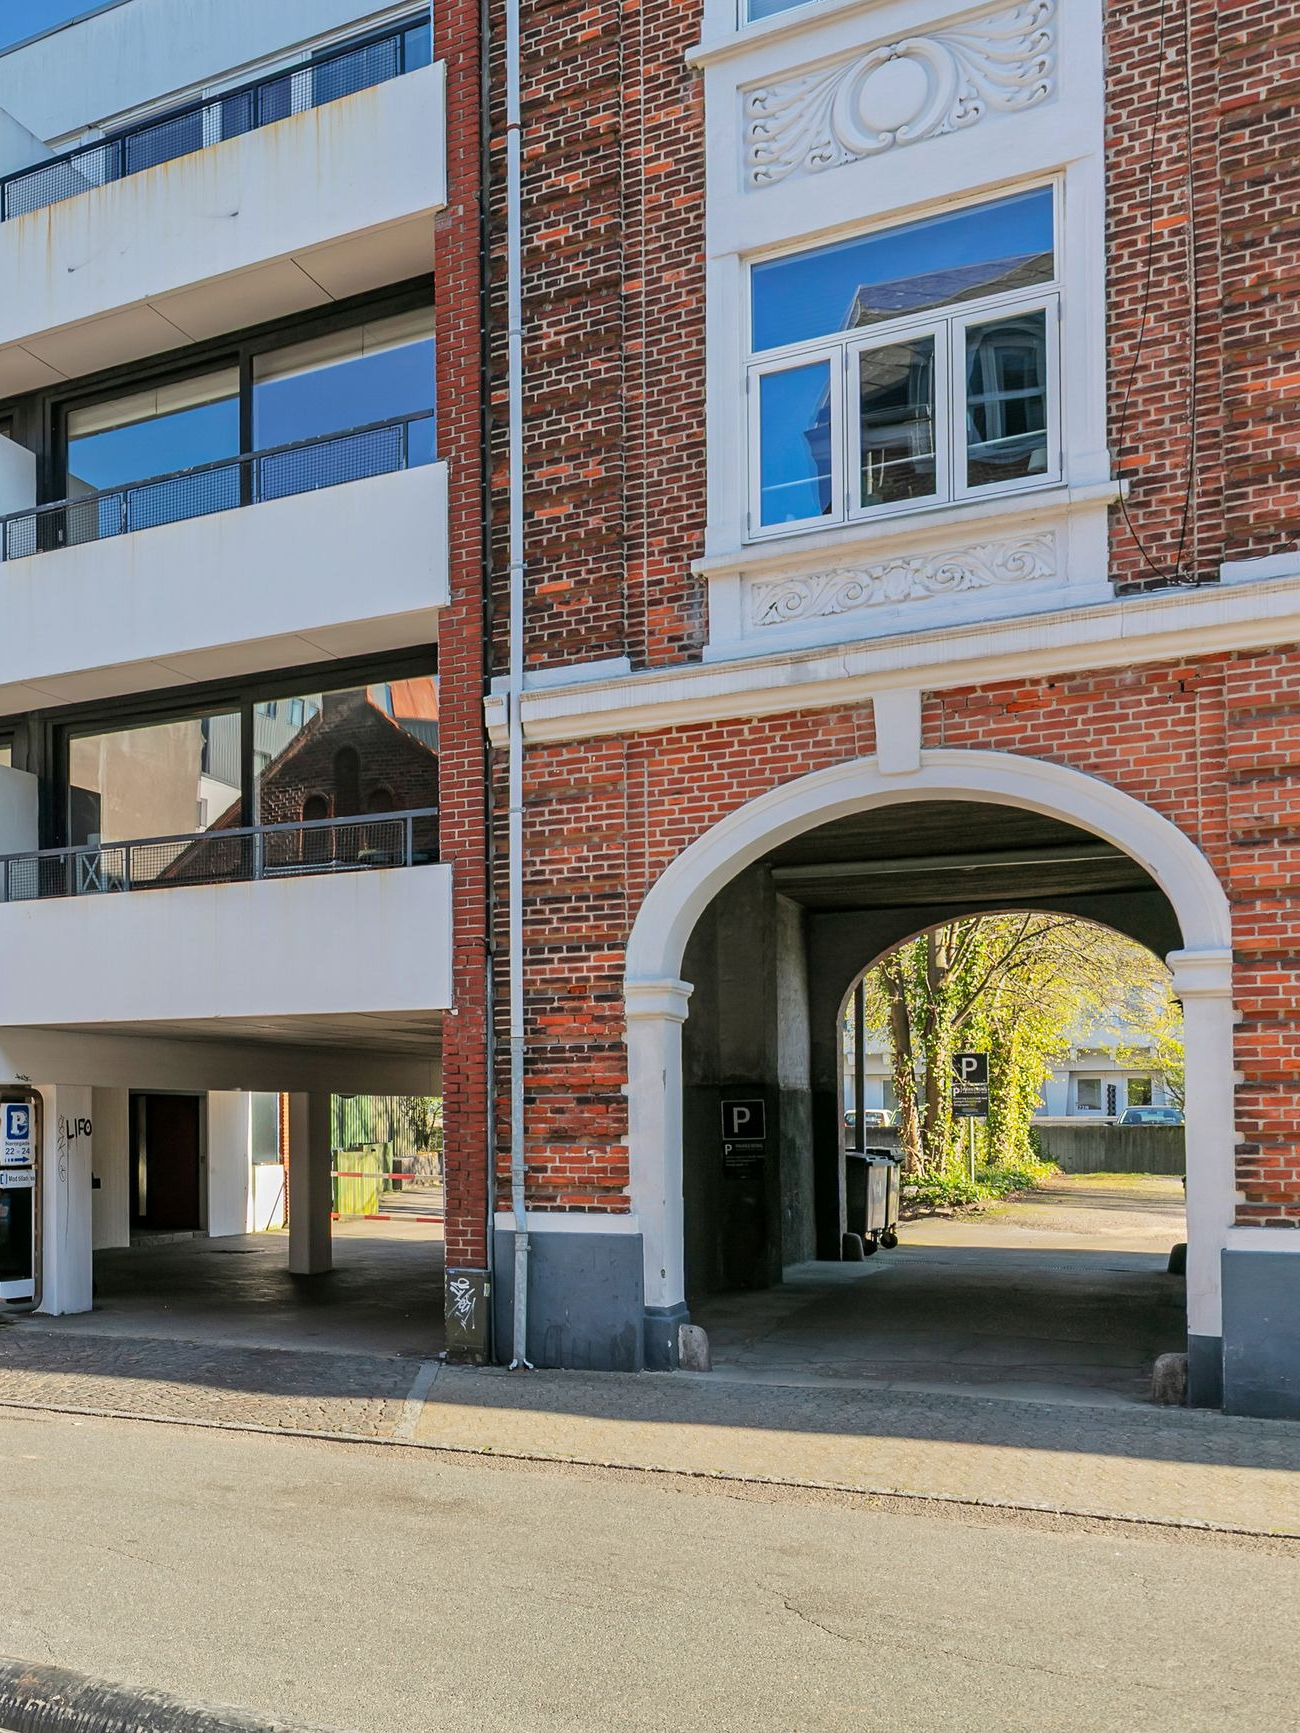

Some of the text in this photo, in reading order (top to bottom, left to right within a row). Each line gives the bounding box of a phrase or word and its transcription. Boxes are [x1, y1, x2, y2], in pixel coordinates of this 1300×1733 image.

[961, 1057, 978, 1080] P
[66, 1118, 92, 1139] LIFO
[733, 1107, 751, 1133] P
[5, 1147, 15, 1155] 22
[21, 1147, 30, 1155] 24
[724, 1144, 732, 1155] P
